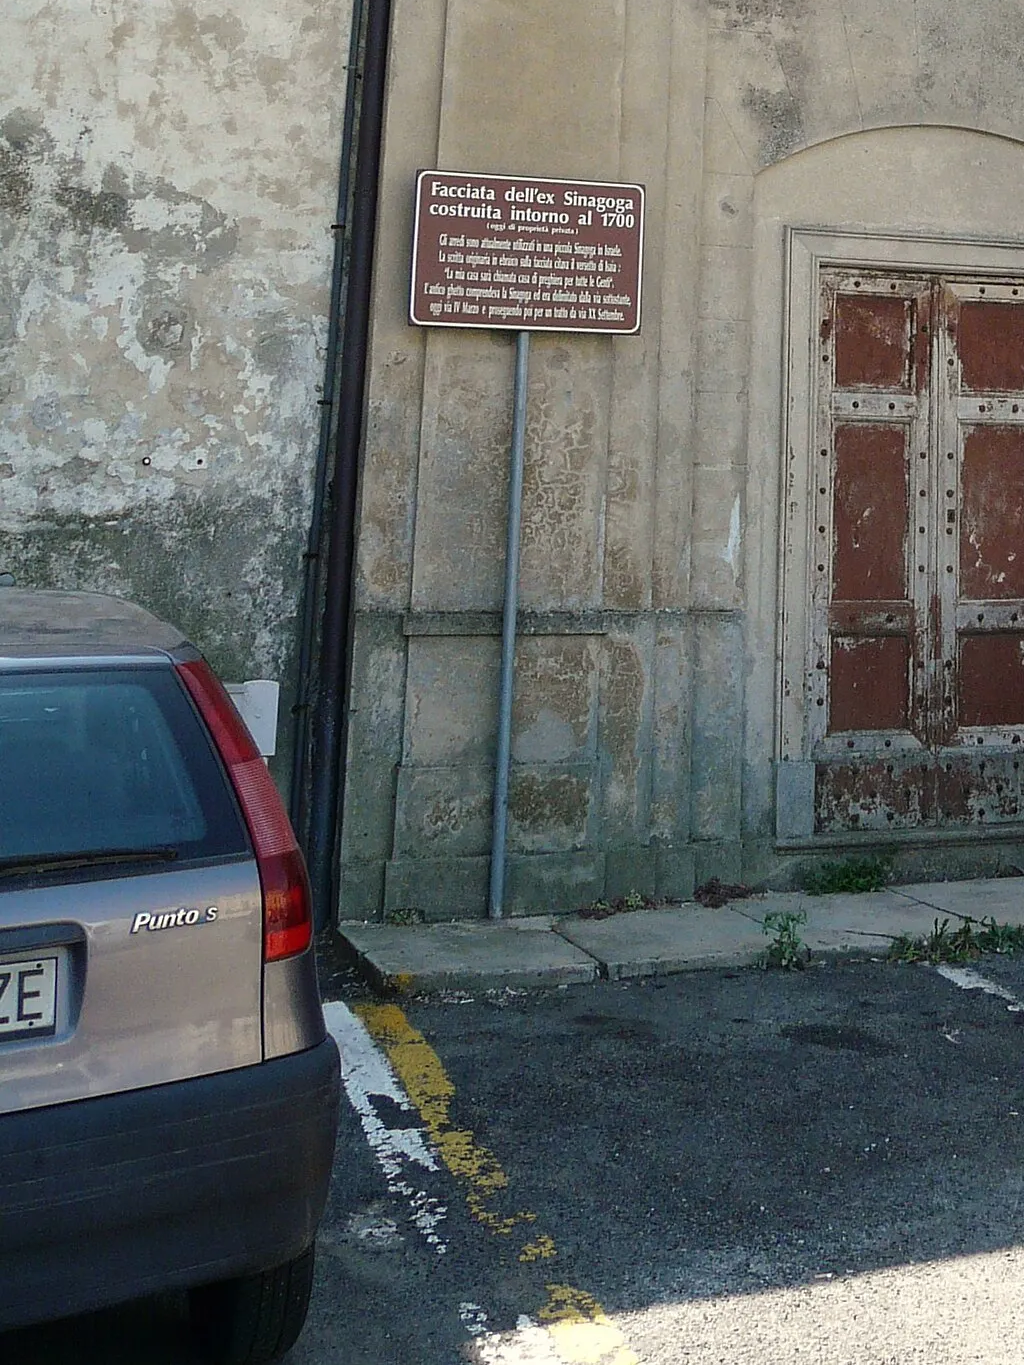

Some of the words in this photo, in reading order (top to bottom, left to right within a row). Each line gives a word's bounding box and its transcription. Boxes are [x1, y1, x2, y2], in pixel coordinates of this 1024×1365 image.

[431, 181, 495, 200] Facciata
[504, 186, 555, 205] dell'ex
[563, 190, 634, 214] Sinagoga
[429, 202, 502, 220] costruita
[510, 205, 570, 224] intorno
[578, 210, 592, 226] al
[601, 212, 635, 228] 1700
[439, 250, 446, 262] La
[574, 241, 596, 258] Sinagoga
[455, 268, 465, 280] mia
[467, 271, 479, 281] casa
[564, 277, 574, 289] per
[589, 275, 595, 287] le
[509, 287, 531, 303] Sinagoga
[593, 291, 601, 304] via
[444, 301, 452, 313] via
[453, 301, 461, 313] IV
[462, 301, 479, 314] Marzo
[534, 307, 544, 320] per
[578, 307, 587, 319] via
[588, 307, 596, 320] XX
[130, 907, 200, 934] Punto
